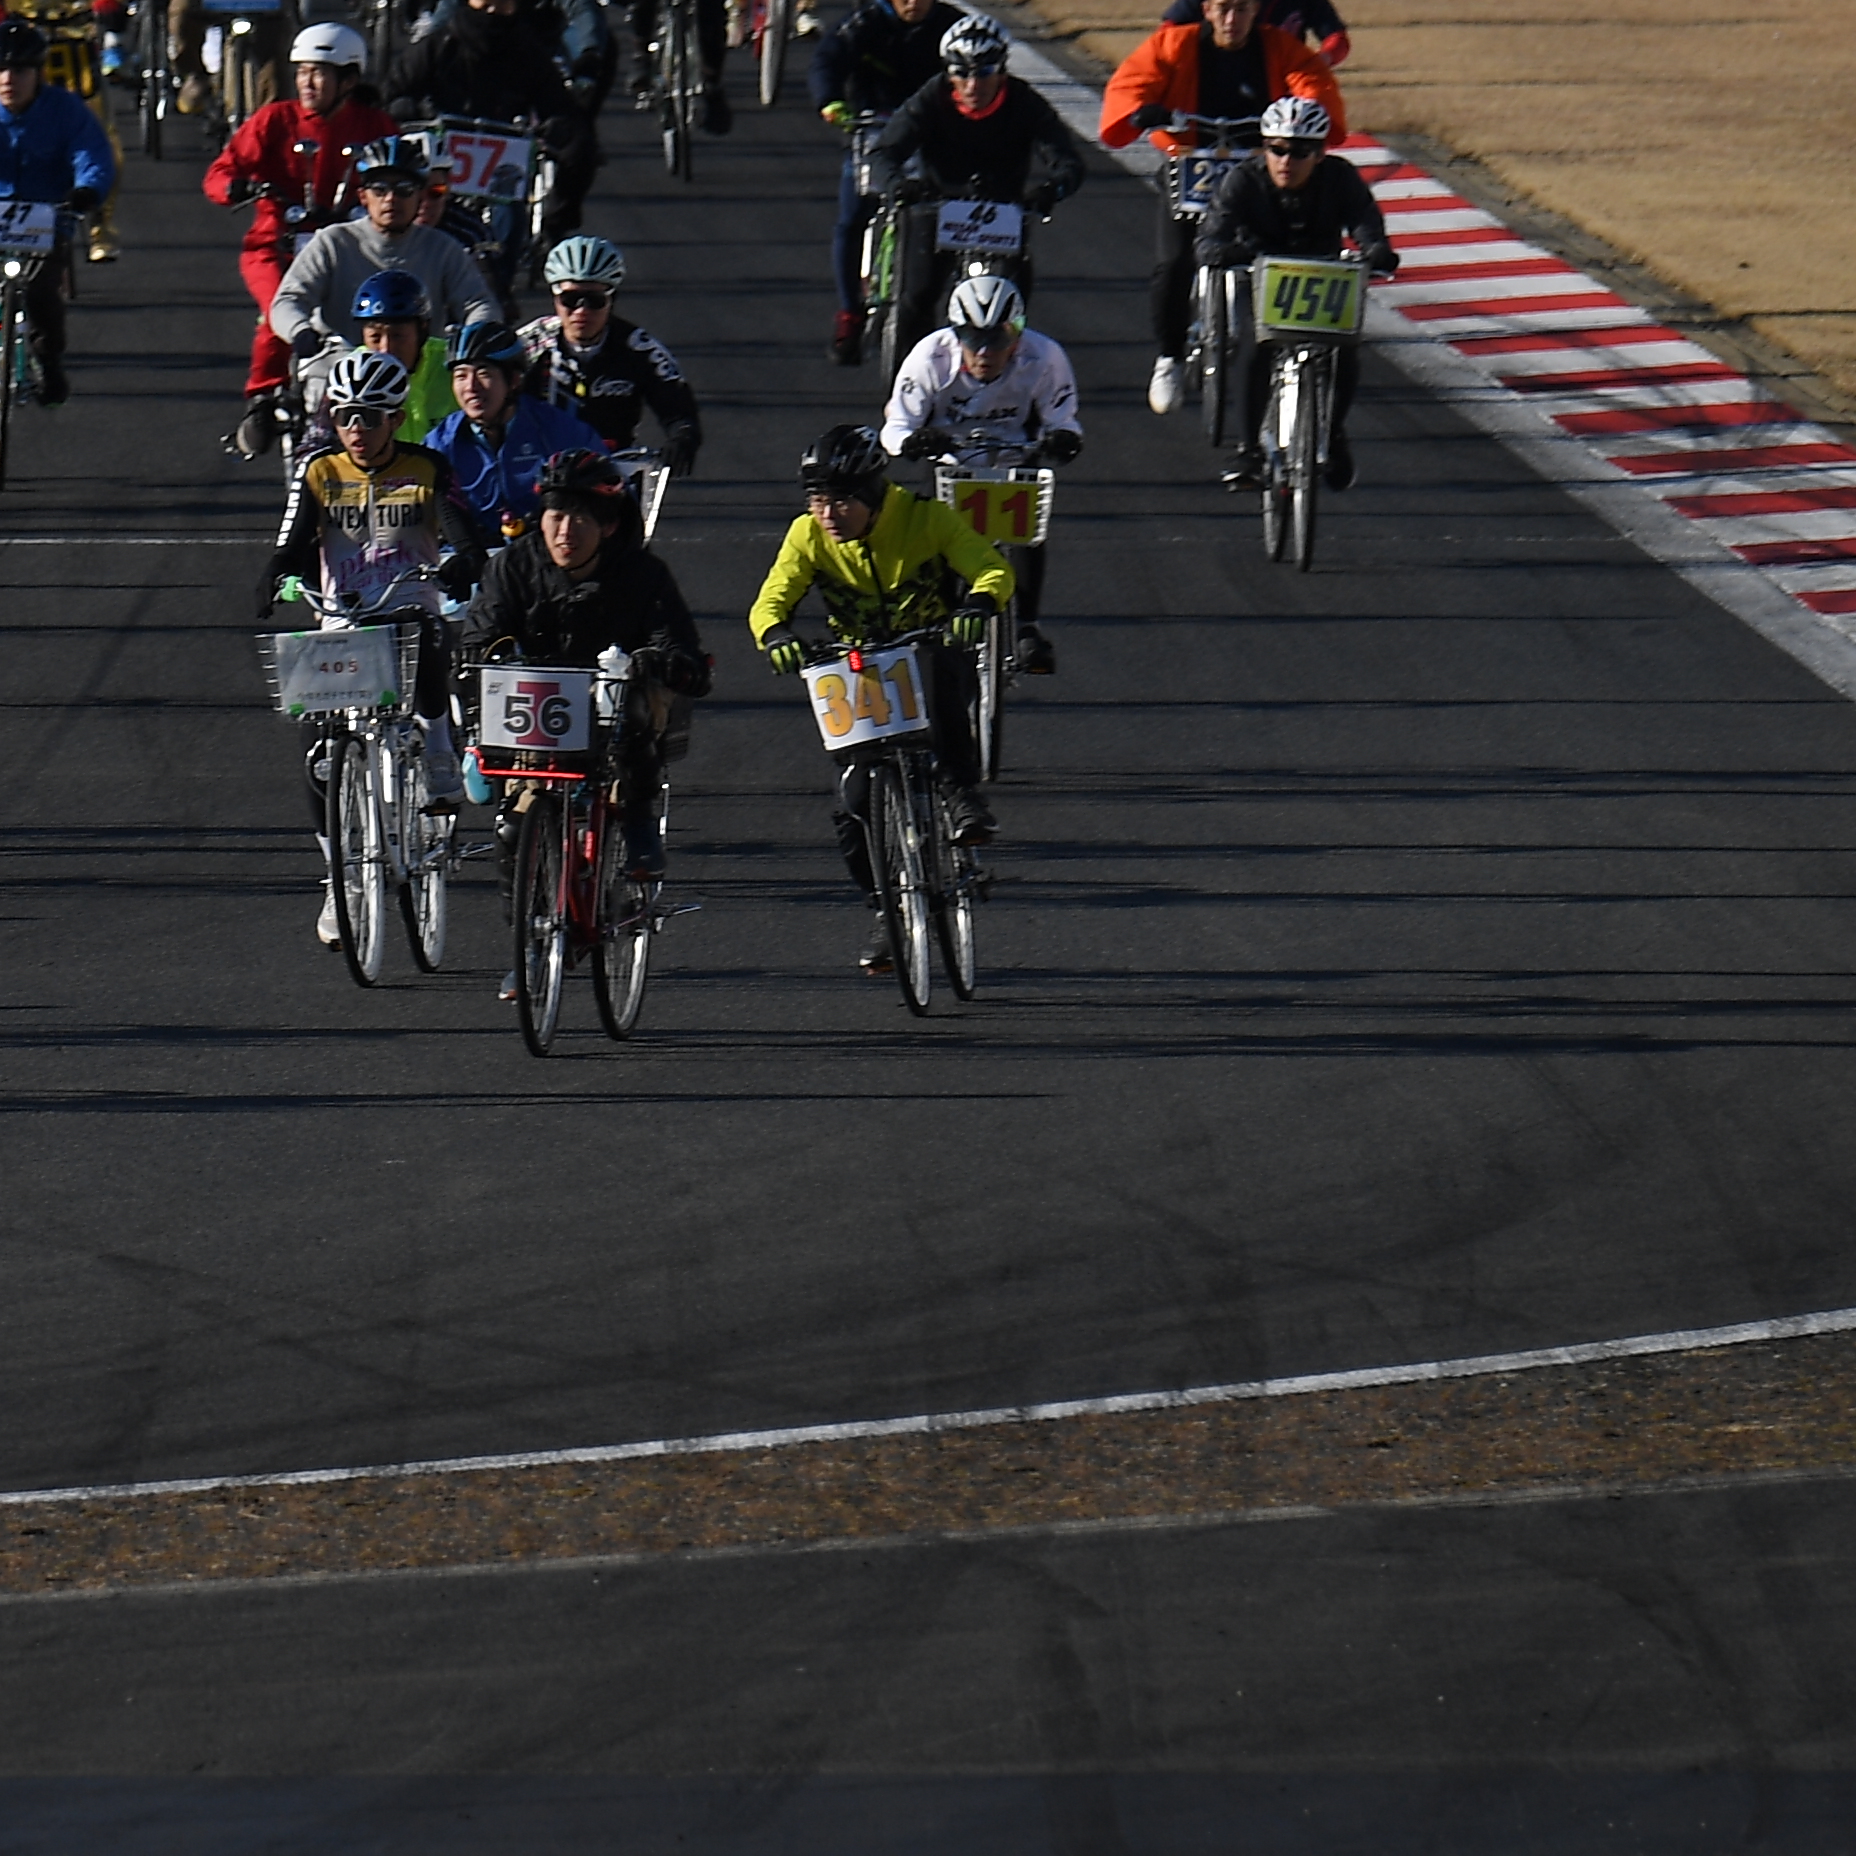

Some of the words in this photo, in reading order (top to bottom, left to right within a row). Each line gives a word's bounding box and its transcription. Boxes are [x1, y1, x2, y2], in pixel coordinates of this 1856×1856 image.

[2, 203, 35, 225] 47
[1273, 274, 1352, 326] 454
[960, 487, 1029, 539] 11
[318, 659, 358, 676] 405
[501, 693, 573, 739] 56
[815, 657, 918, 739] 341
